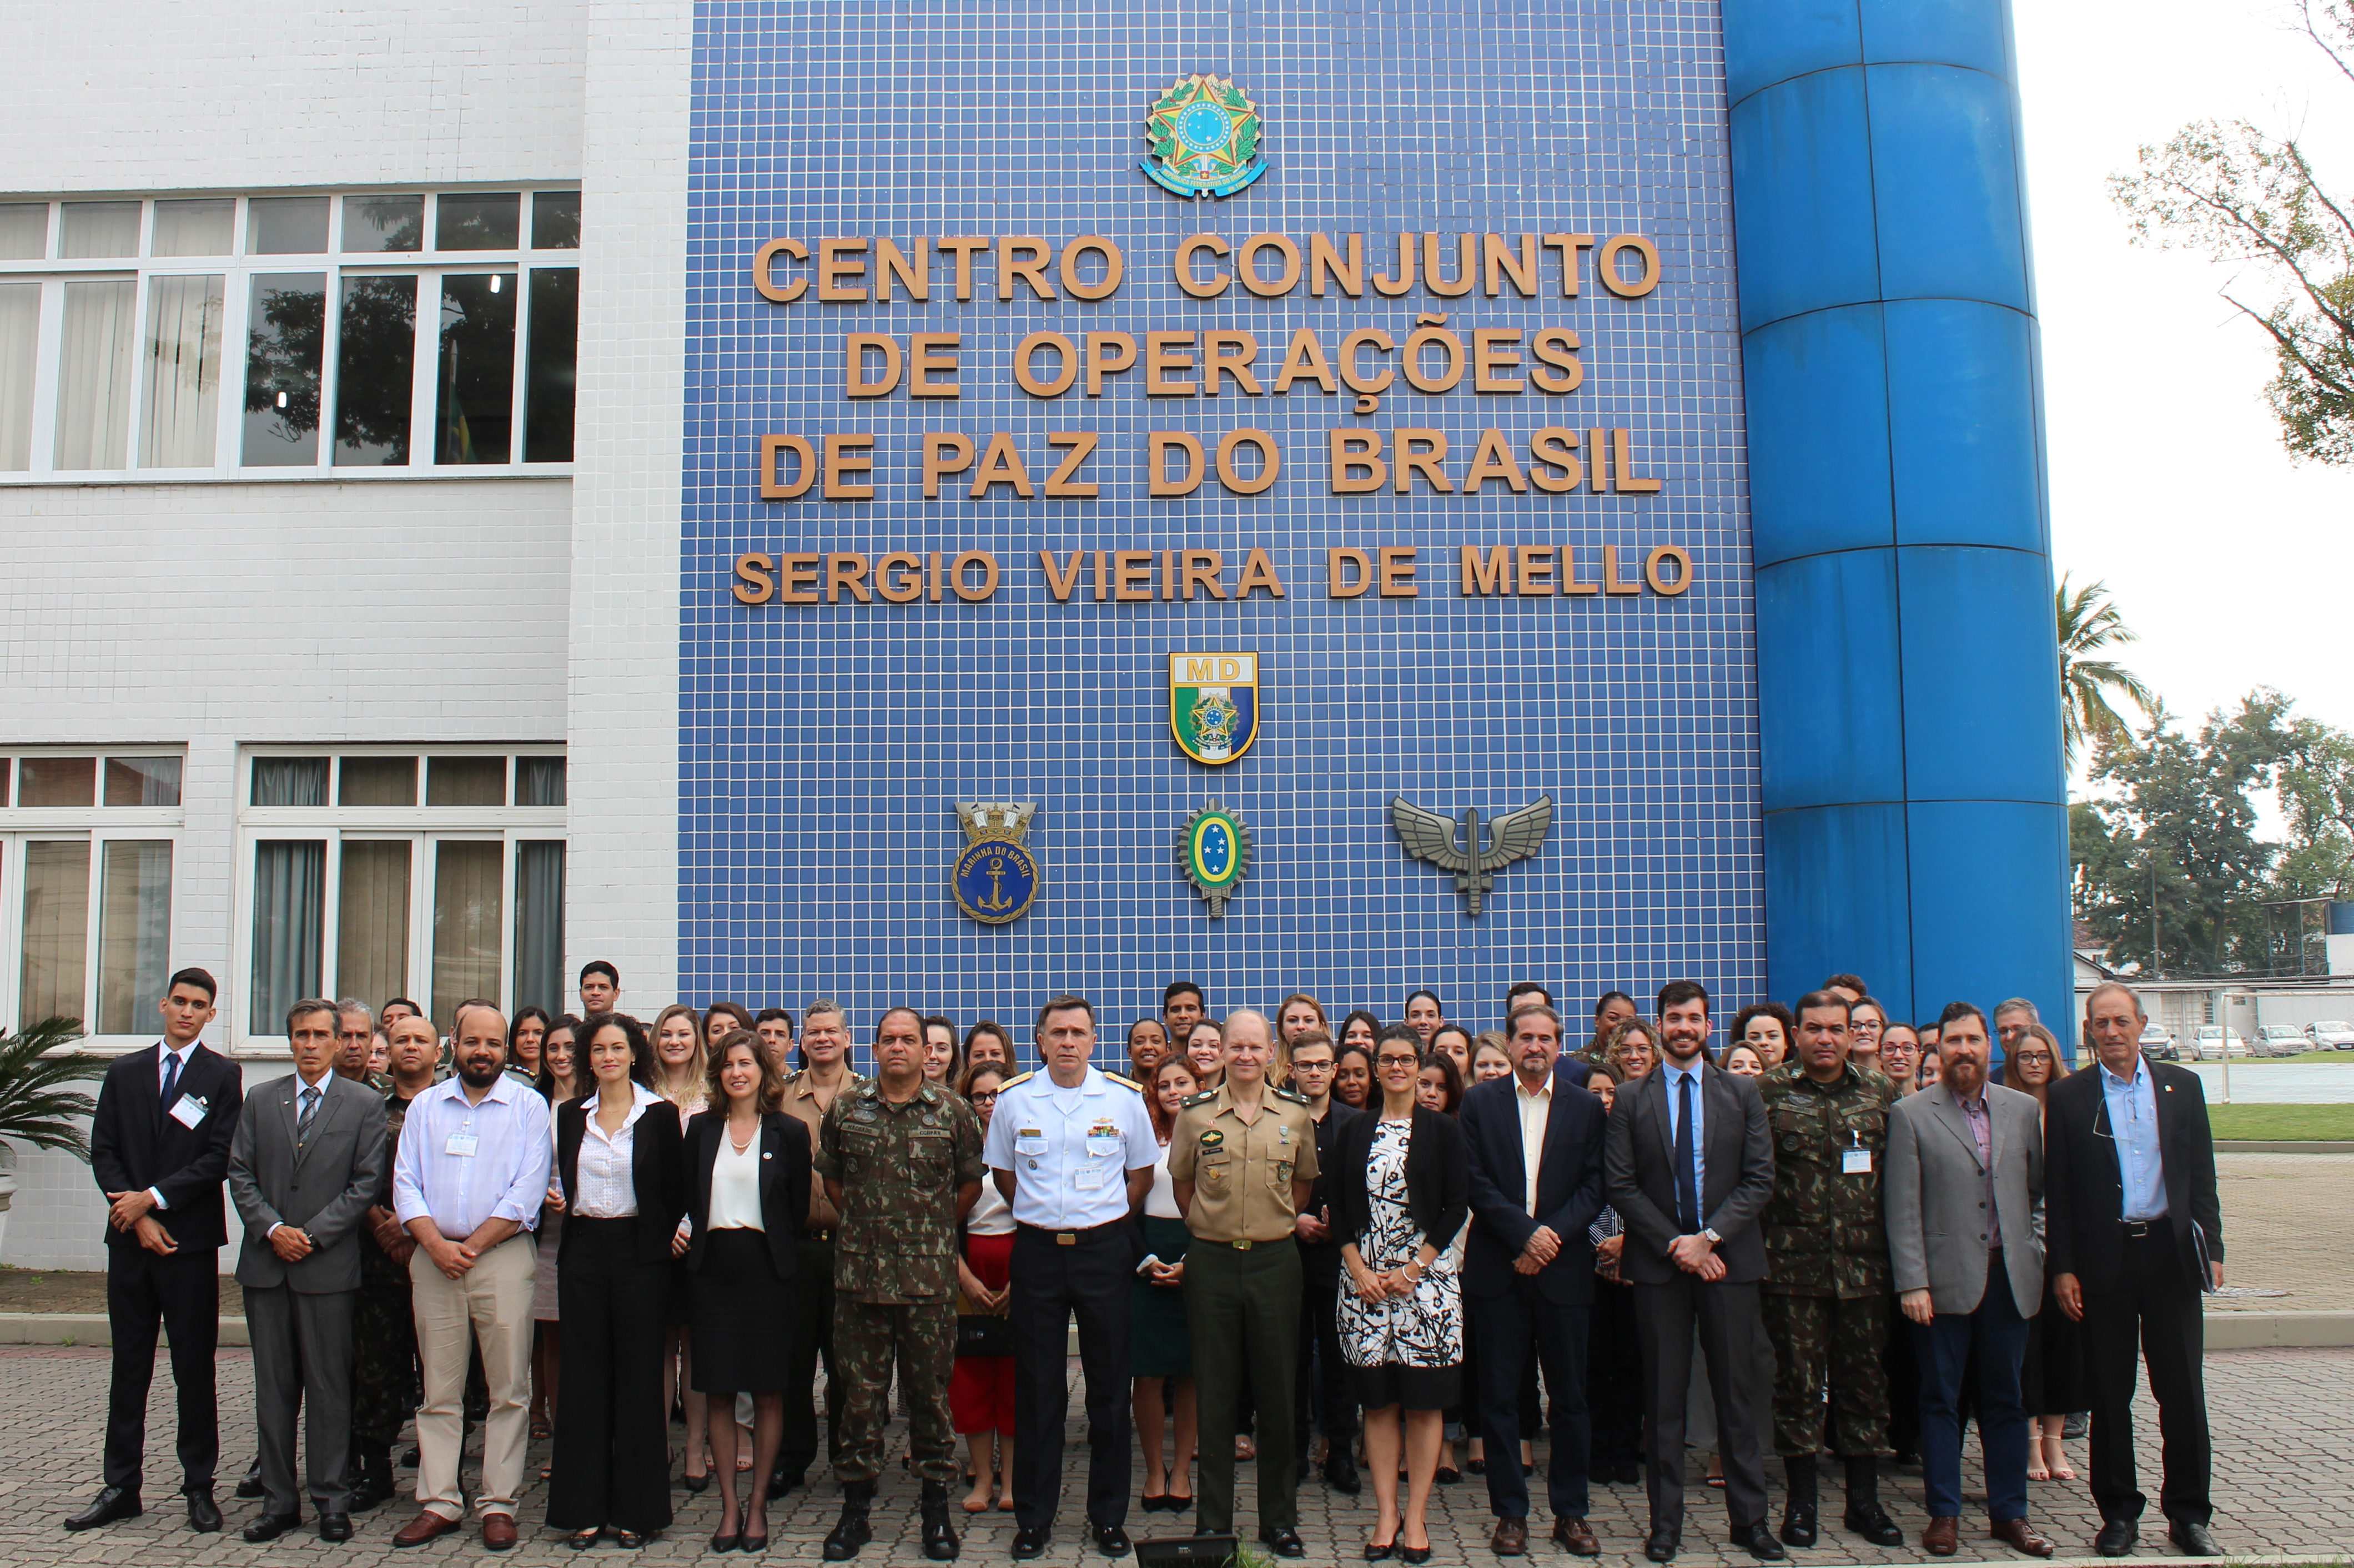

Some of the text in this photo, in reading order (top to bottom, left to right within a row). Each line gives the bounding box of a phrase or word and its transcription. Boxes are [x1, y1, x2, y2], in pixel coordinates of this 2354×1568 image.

[1163, 179, 1188, 194] Novembro
[1230, 169, 1248, 182] BRASIL
[753, 232, 1662, 303] CENTRO CONJUNTO
[845, 312, 1584, 414] DE OPERAÇÕES
[759, 426, 1662, 499] DE PAZ DO BRASIL
[732, 544, 1693, 604] SERGIO VIEIRA DE MELLO
[1187, 659, 1241, 681] MD
[960, 846, 1030, 878] MARINHA DO BRASIL
